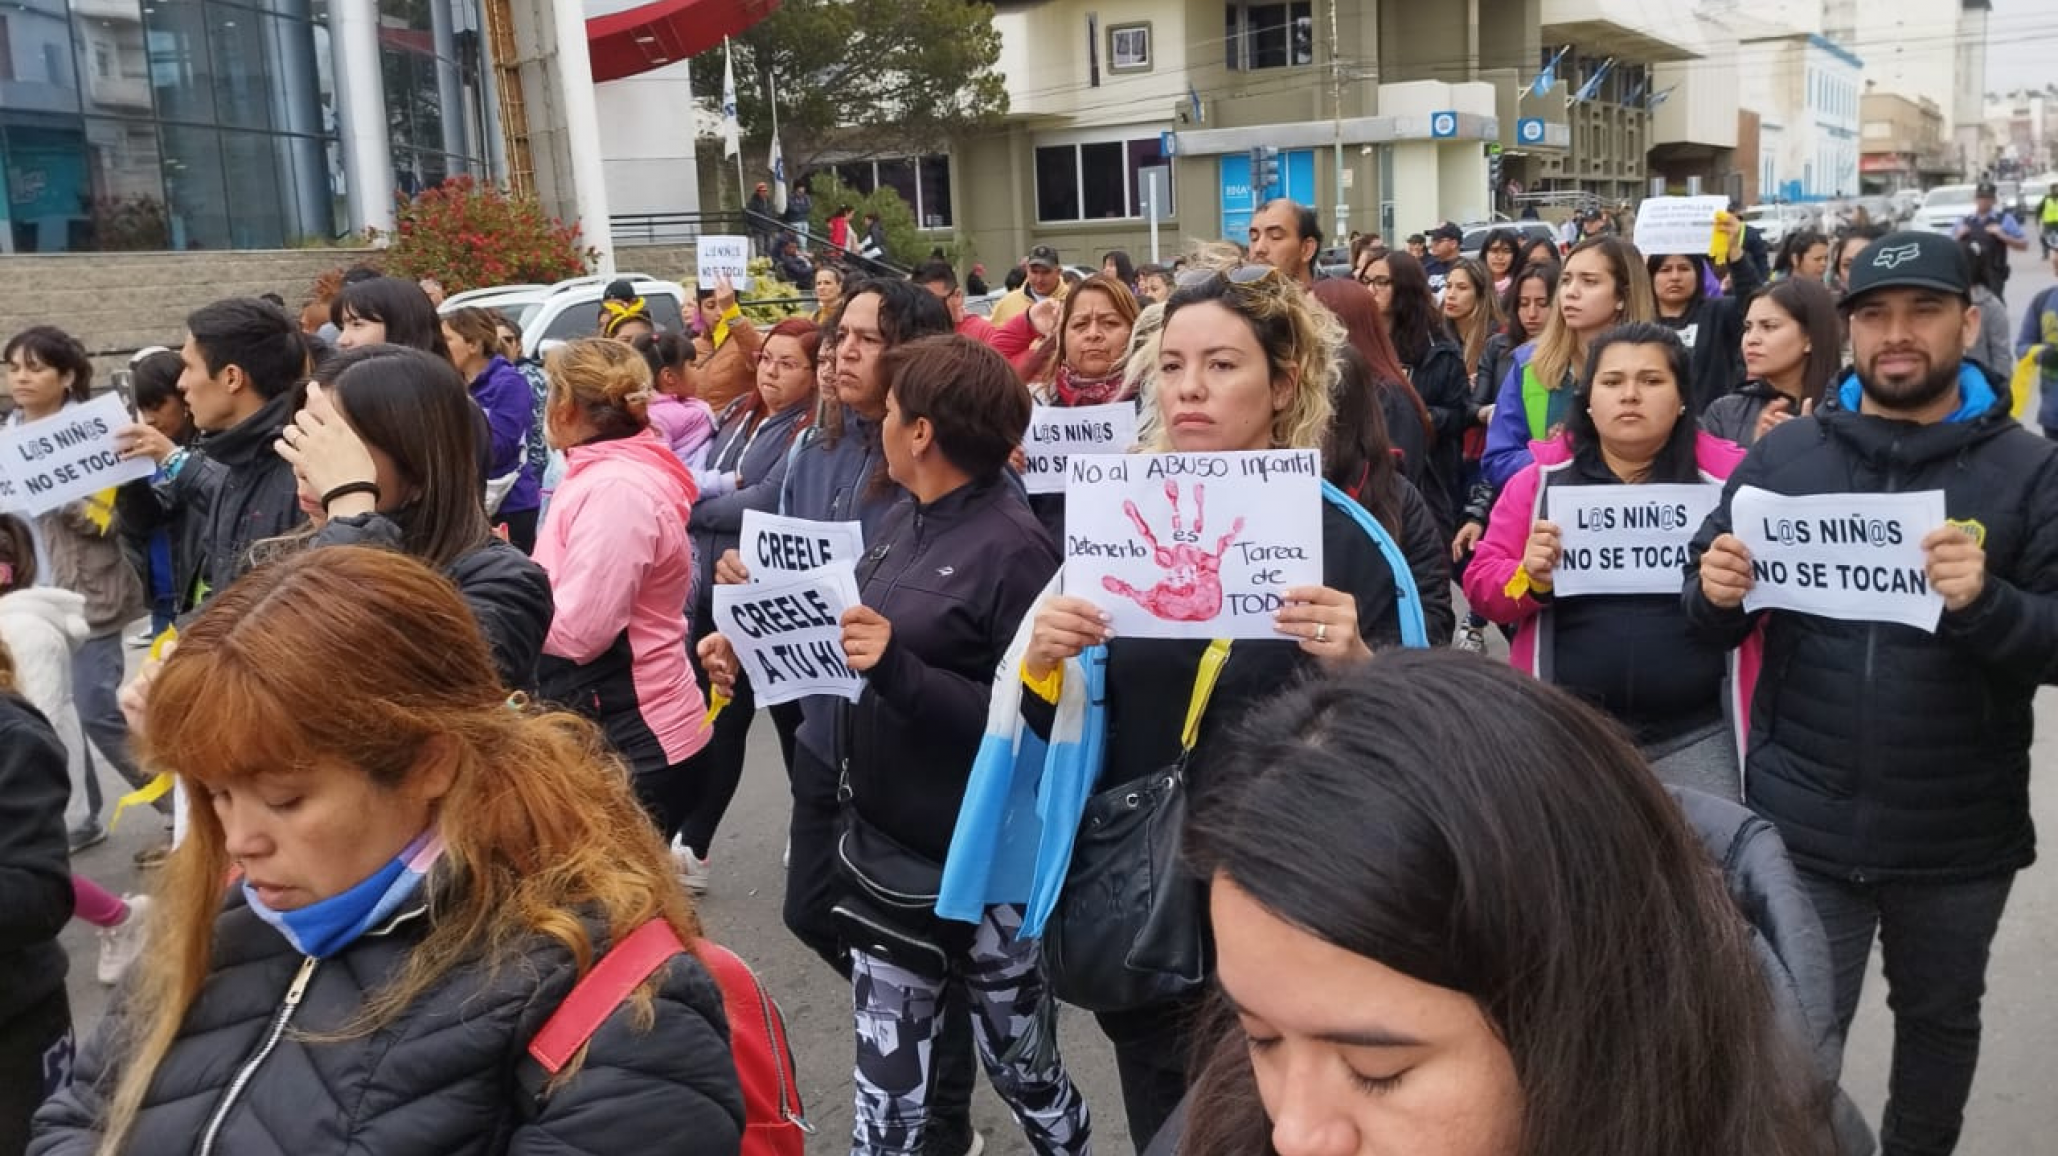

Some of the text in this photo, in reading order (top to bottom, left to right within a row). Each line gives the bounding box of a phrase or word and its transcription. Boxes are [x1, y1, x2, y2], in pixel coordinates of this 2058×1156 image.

[1033, 419, 1113, 444] L@S NIÑ@S
[24, 473, 54, 494] NO
[54, 464, 80, 484] SE
[77, 450, 120, 474] TOC
[1026, 456, 1049, 474] NO
[1109, 459, 1128, 483] al
[1146, 455, 1228, 479] ABUSO
[1577, 500, 1688, 532] L@S NIÑ@S
[1763, 513, 1903, 547] L@S NIÑ@S
[1068, 529, 1309, 566] Detenerlo es Tarea
[1563, 545, 1688, 570] NO SE TOCA
[1251, 568, 1287, 585] de
[1752, 559, 1927, 596] NO SE TOCAN
[731, 589, 837, 638] CREELE
[1226, 592, 1285, 616] TOD
[754, 640, 857, 685] A TU HI
